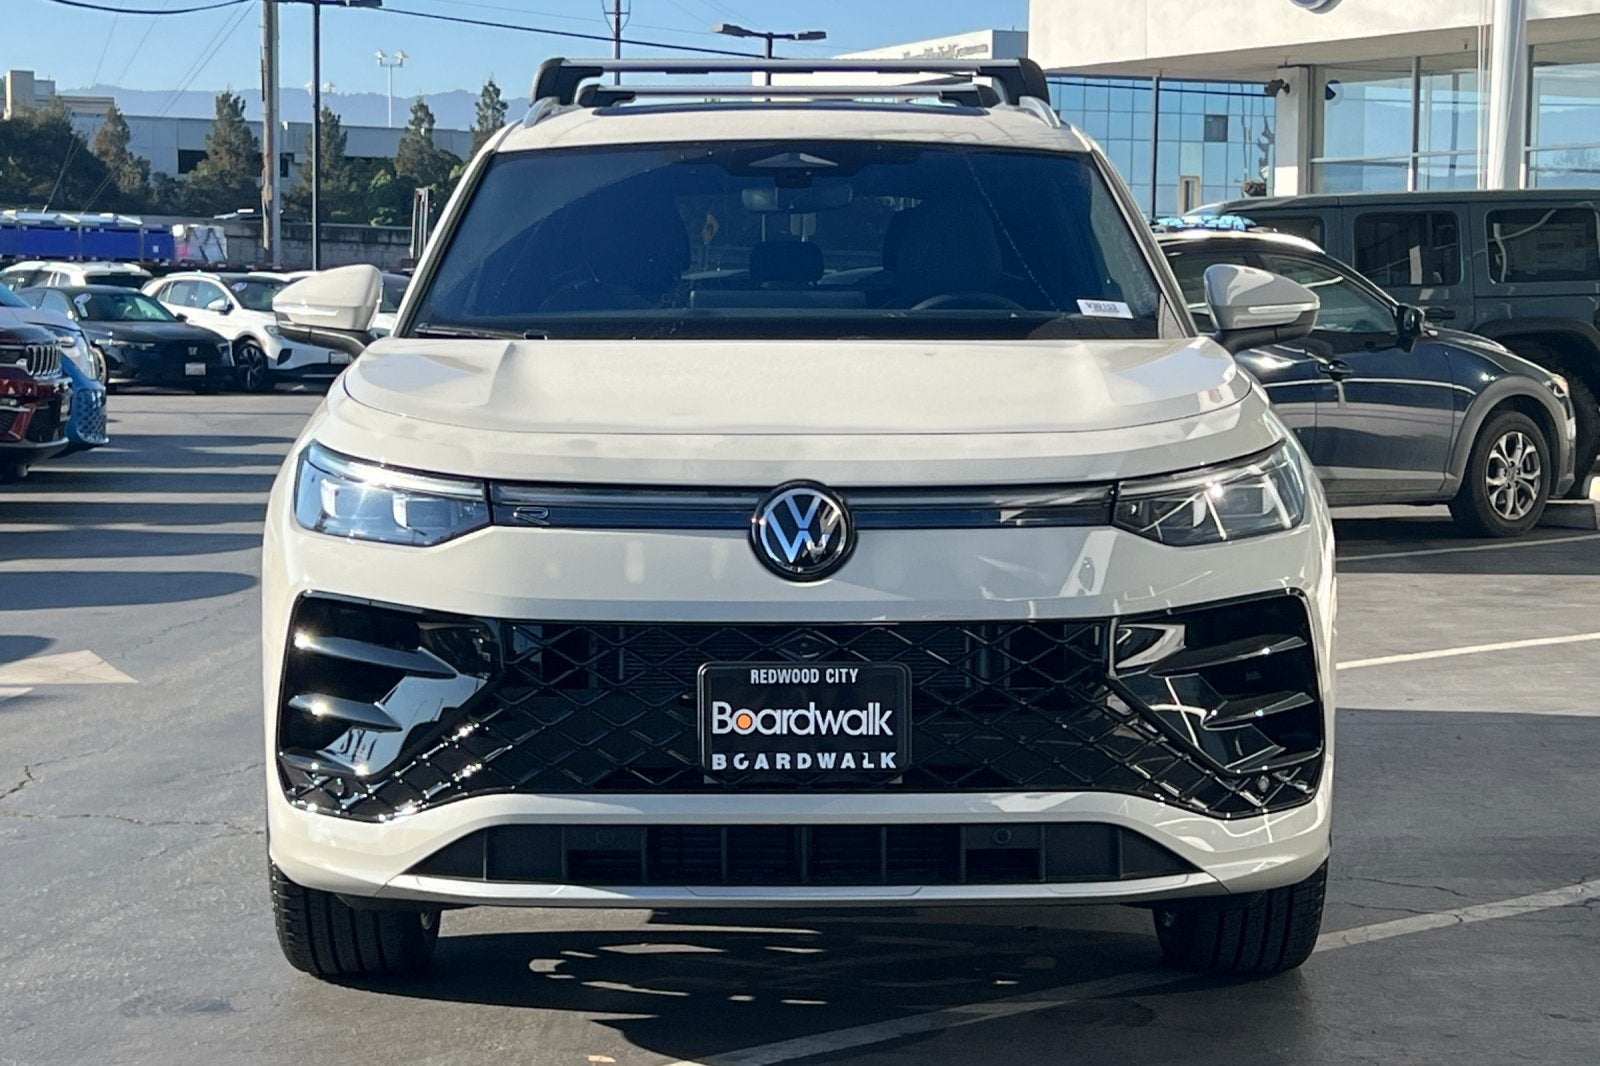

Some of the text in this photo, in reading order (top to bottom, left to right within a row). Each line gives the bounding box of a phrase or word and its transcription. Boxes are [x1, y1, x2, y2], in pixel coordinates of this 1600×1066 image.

[750, 668, 859, 684] REDWOOD CITY
[712, 701, 893, 736] Boardwalk
[712, 752, 896, 770] BOARDWALK
